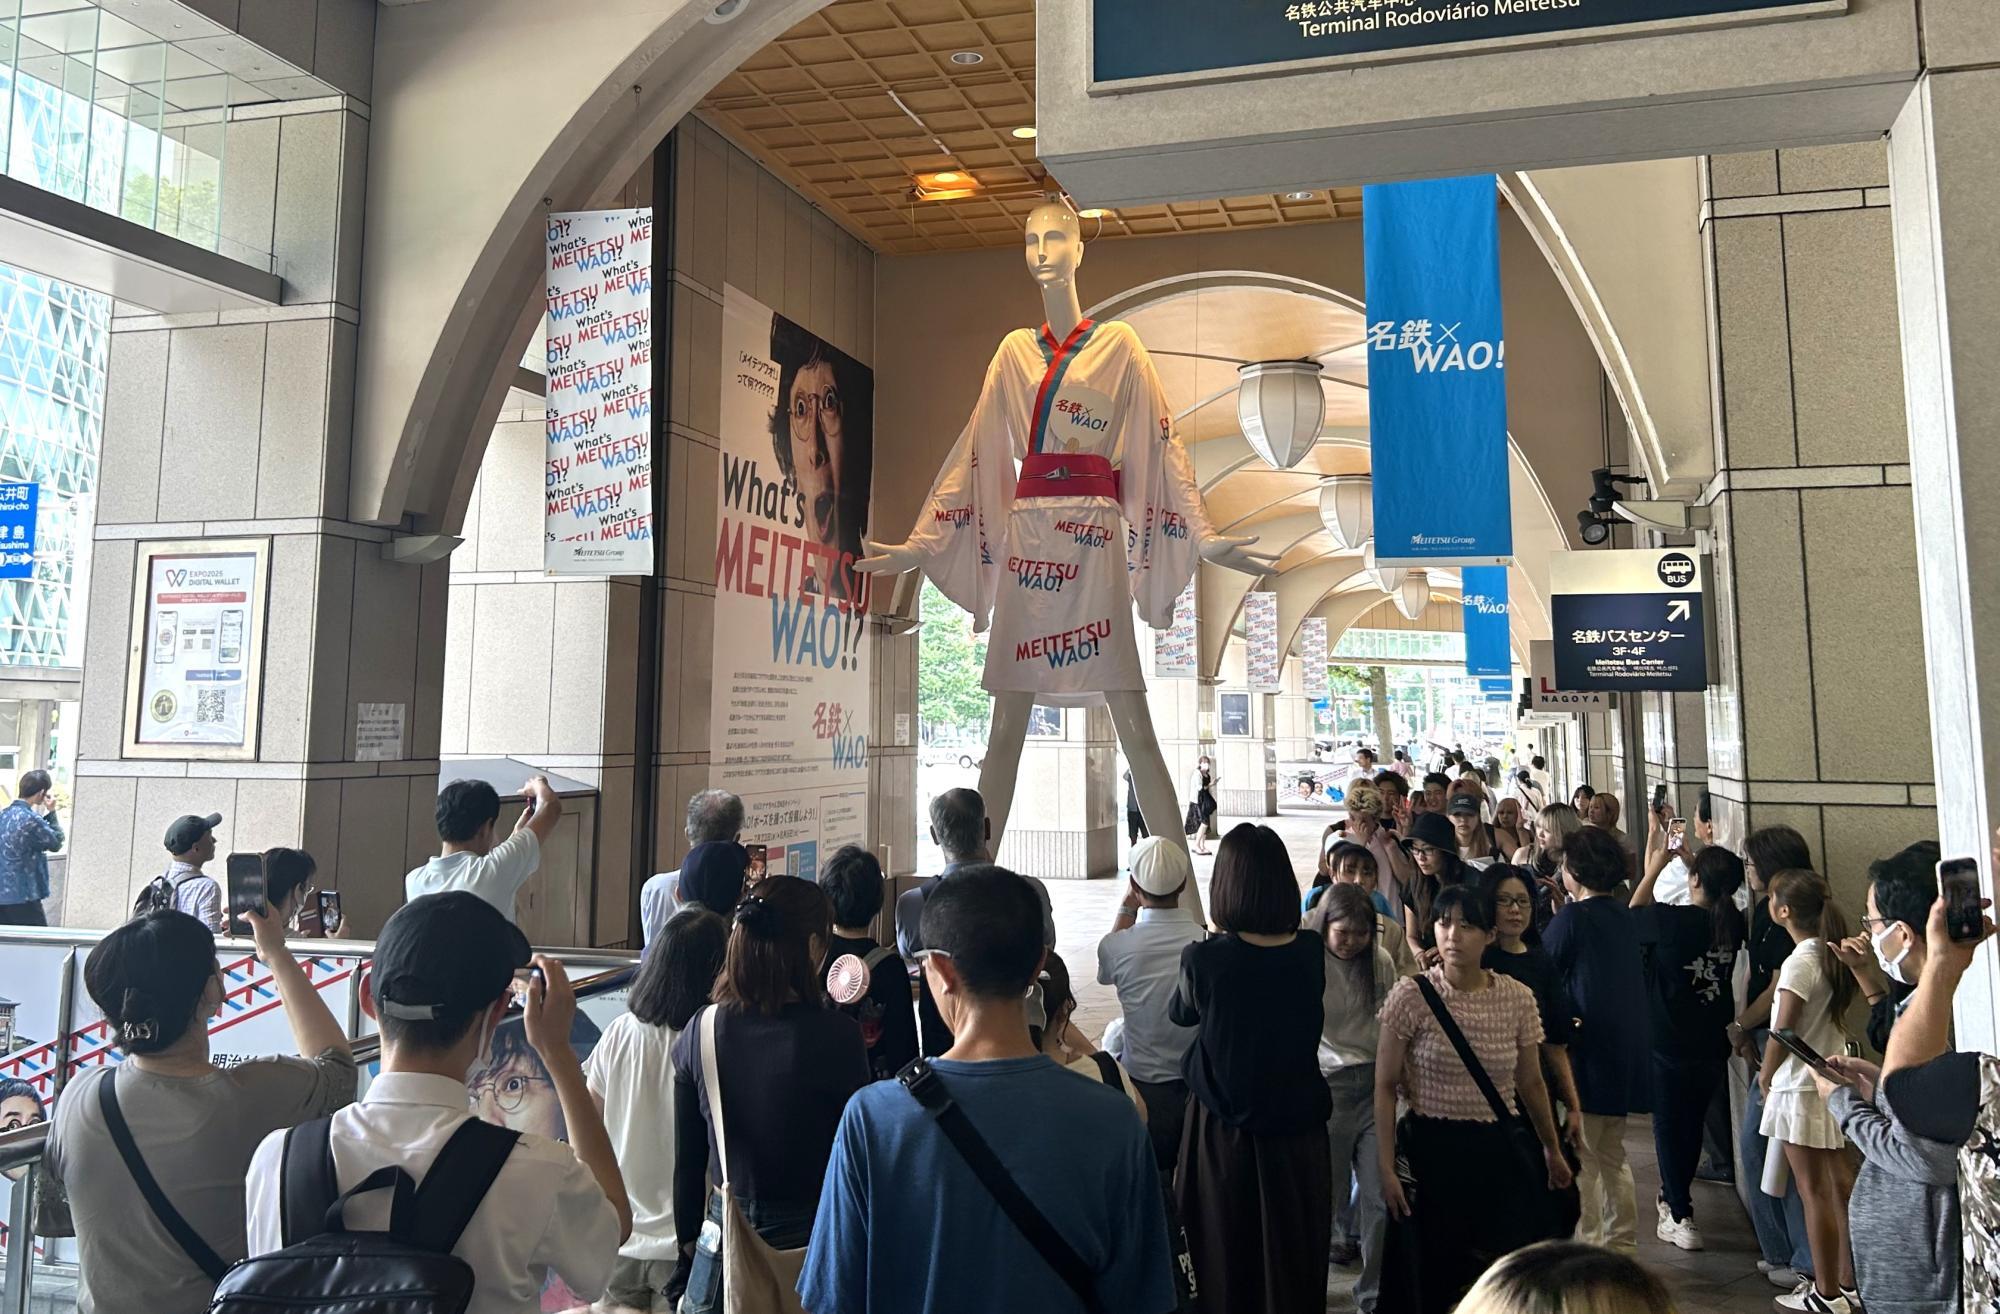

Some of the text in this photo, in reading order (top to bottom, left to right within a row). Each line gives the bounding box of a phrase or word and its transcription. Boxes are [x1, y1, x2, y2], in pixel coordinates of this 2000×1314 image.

[1299, 17, 1380, 38] Terminal
[1386, 2, 1490, 28] Rodoviário
[550, 237, 587, 254] What's
[552, 234, 624, 270] MEITETSU
[577, 247, 623, 272] WAO!?
[602, 260, 639, 278] What's
[550, 297, 596, 322] WAO!?
[576, 310, 613, 328] What's
[578, 308, 649, 344] MEITETSU
[604, 320, 648, 346] WAO!?
[549, 360, 586, 378] What's
[1412, 341, 1505, 374] WAO!
[551, 358, 624, 393] MEITETSU
[576, 371, 622, 396] WAO!?
[602, 384, 638, 402] What's
[549, 420, 595, 445] WAO!?
[1070, 412, 1108, 432] WAO!
[574, 433, 612, 451] What's
[576, 432, 648, 466] MEITETSU
[602, 445, 648, 470] WAO!?
[546, 482, 584, 500] What's
[548, 482, 622, 516] MEITETSU
[723, 452, 806, 529] What's
[574, 494, 621, 520] WAO!?
[599, 508, 638, 526] What's
[1074, 533, 1105, 548] WAO!
[1410, 533, 1476, 544] MEITETSU Group
[715, 517, 872, 615] MEITETSU
[1018, 572, 1064, 592] WAO!
[1666, 575, 1687, 584] BUS
[1477, 603, 1509, 614] WAO!
[771, 592, 863, 672] WAO!?
[1016, 619, 1111, 662] MEITETSU
[1572, 630, 1685, 644] 名鉄バスセンター
[1047, 638, 1100, 669] WAO!
[832, 735, 870, 770] WAO!
[212, 1054, 258, 1070] 明治
